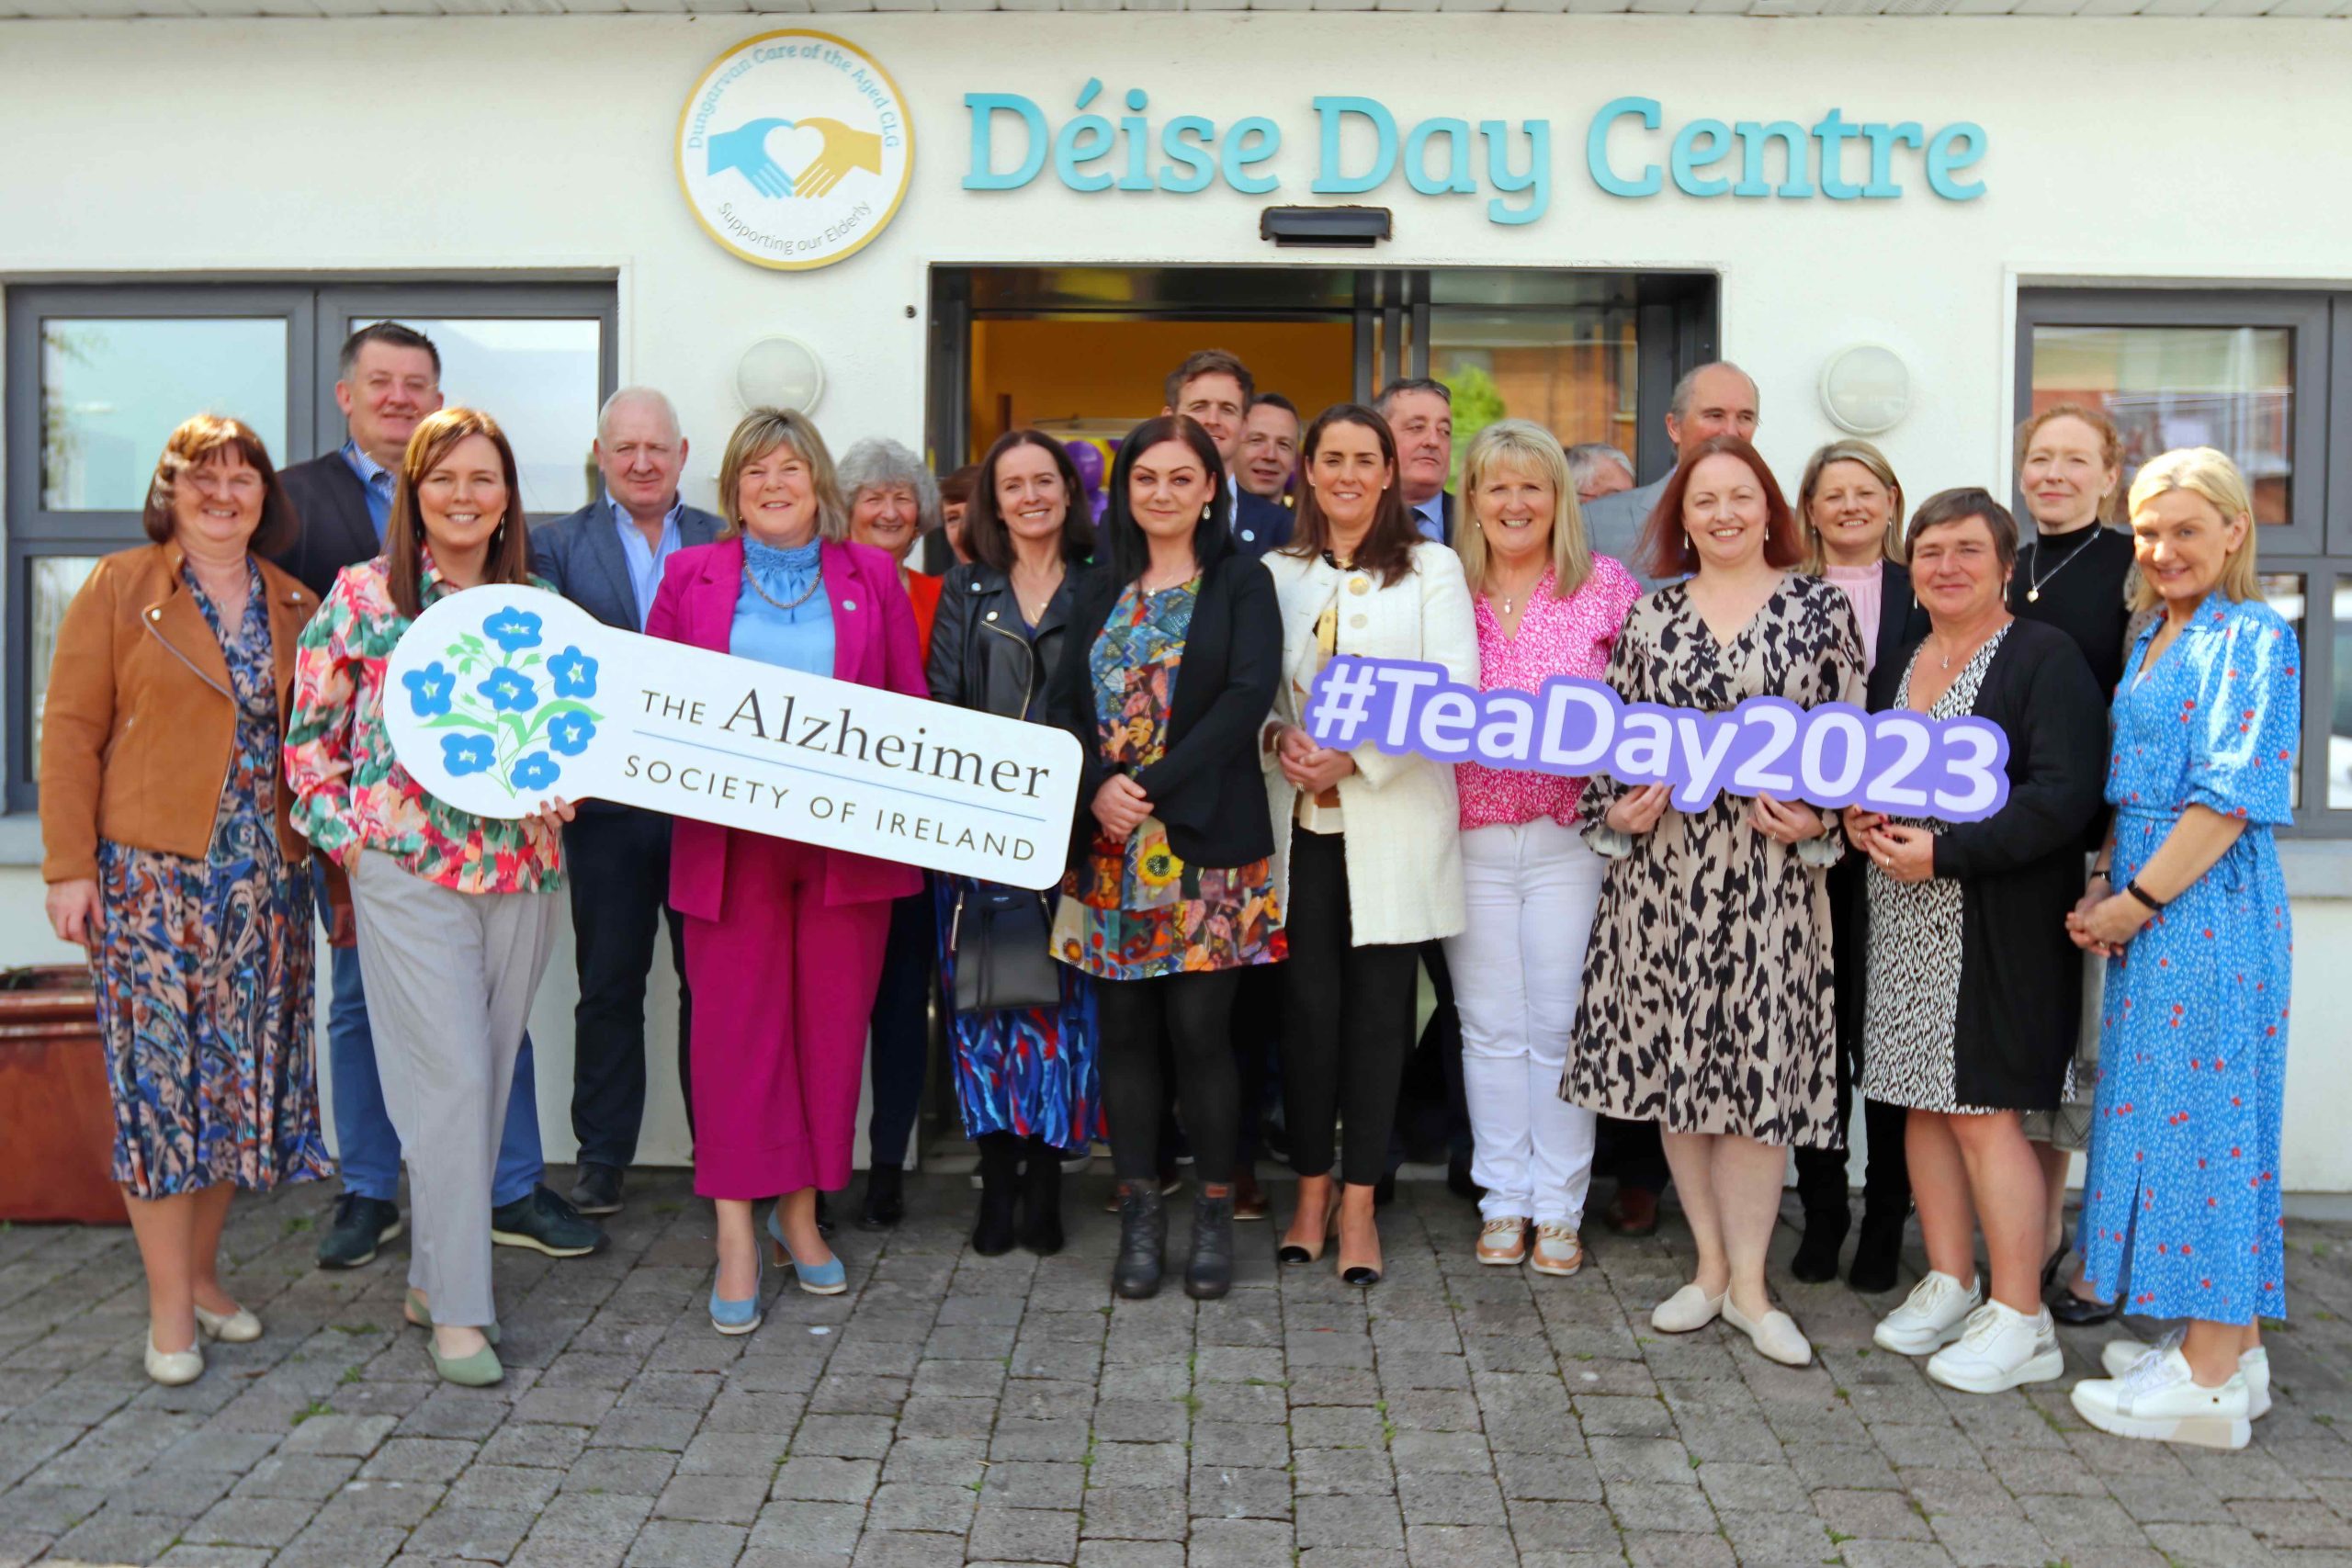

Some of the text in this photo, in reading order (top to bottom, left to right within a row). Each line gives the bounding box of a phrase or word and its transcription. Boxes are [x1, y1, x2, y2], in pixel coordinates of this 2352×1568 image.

[688, 44, 899, 149] Dungarvan Care of the Aged CLG
[962, 78, 1986, 225] Déise Day Centre
[718, 200, 872, 255] Supporting our Elderly
[641, 688, 1050, 800] THE Alzheimer
[1313, 663, 1998, 813] #TeaDay2023
[624, 753, 1036, 863] SOCIETY OF IRELAND
